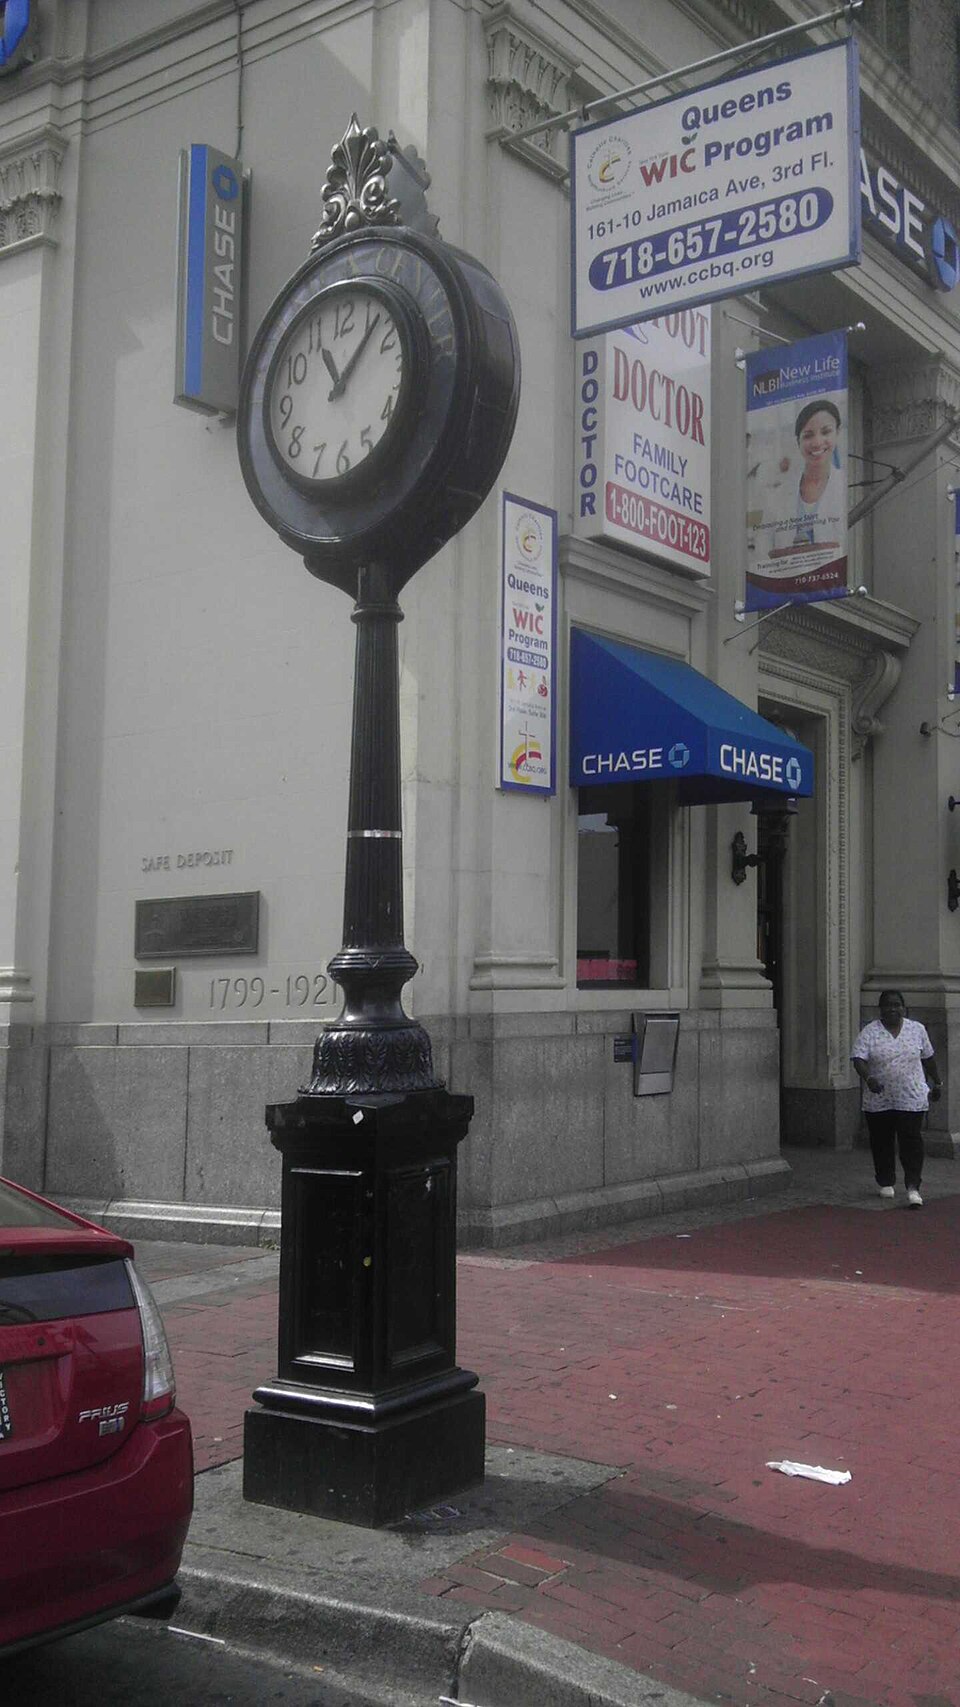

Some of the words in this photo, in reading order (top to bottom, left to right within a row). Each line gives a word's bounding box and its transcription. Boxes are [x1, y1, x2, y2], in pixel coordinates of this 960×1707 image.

[681, 81, 792, 132] Queens
[640, 147, 696, 187] WIC
[704, 111, 834, 166] Program
[587, 211, 642, 240] 161-10
[647, 189, 719, 221] Jamaica
[725, 172, 766, 198] Ave,
[772, 159, 803, 184] 3rd
[811, 151, 834, 171] Fl.
[602, 192, 820, 285] 718-657-2580
[212, 204, 236, 346] CHASE
[639, 250, 774, 299] www.ccbq.org
[308, 317, 322, 355] 11
[333, 303, 355, 341] 12
[380, 320, 397, 354] 2
[286, 354, 307, 389] 10
[753, 377, 780, 397] NLBI
[780, 362, 811, 382] New
[814, 355, 840, 372] Life
[280, 395, 293, 430] 9
[380, 395, 394, 421] 4
[613, 346, 705, 446] DOCTOR
[288, 425, 306, 458] 8
[360, 425, 375, 451] 5
[580, 350, 599, 518] DOCTOR
[312, 443, 327, 478] 7
[336, 439, 350, 474] 6
[633, 432, 688, 478] FAMILY
[615, 454, 703, 515] FOOTCARE
[610, 488, 706, 557] 1-800-FOOT-123
[507, 573, 549, 599] Queens
[508, 629, 548, 651] Program
[512, 607, 544, 636] WIC
[582, 747, 663, 775] CHASE
[719, 743, 783, 784] CHASE
[141, 854, 171, 873] SAFE
[177, 849, 234, 869] DEPOSIT
[78, 1401, 130, 1424] PRIUS
